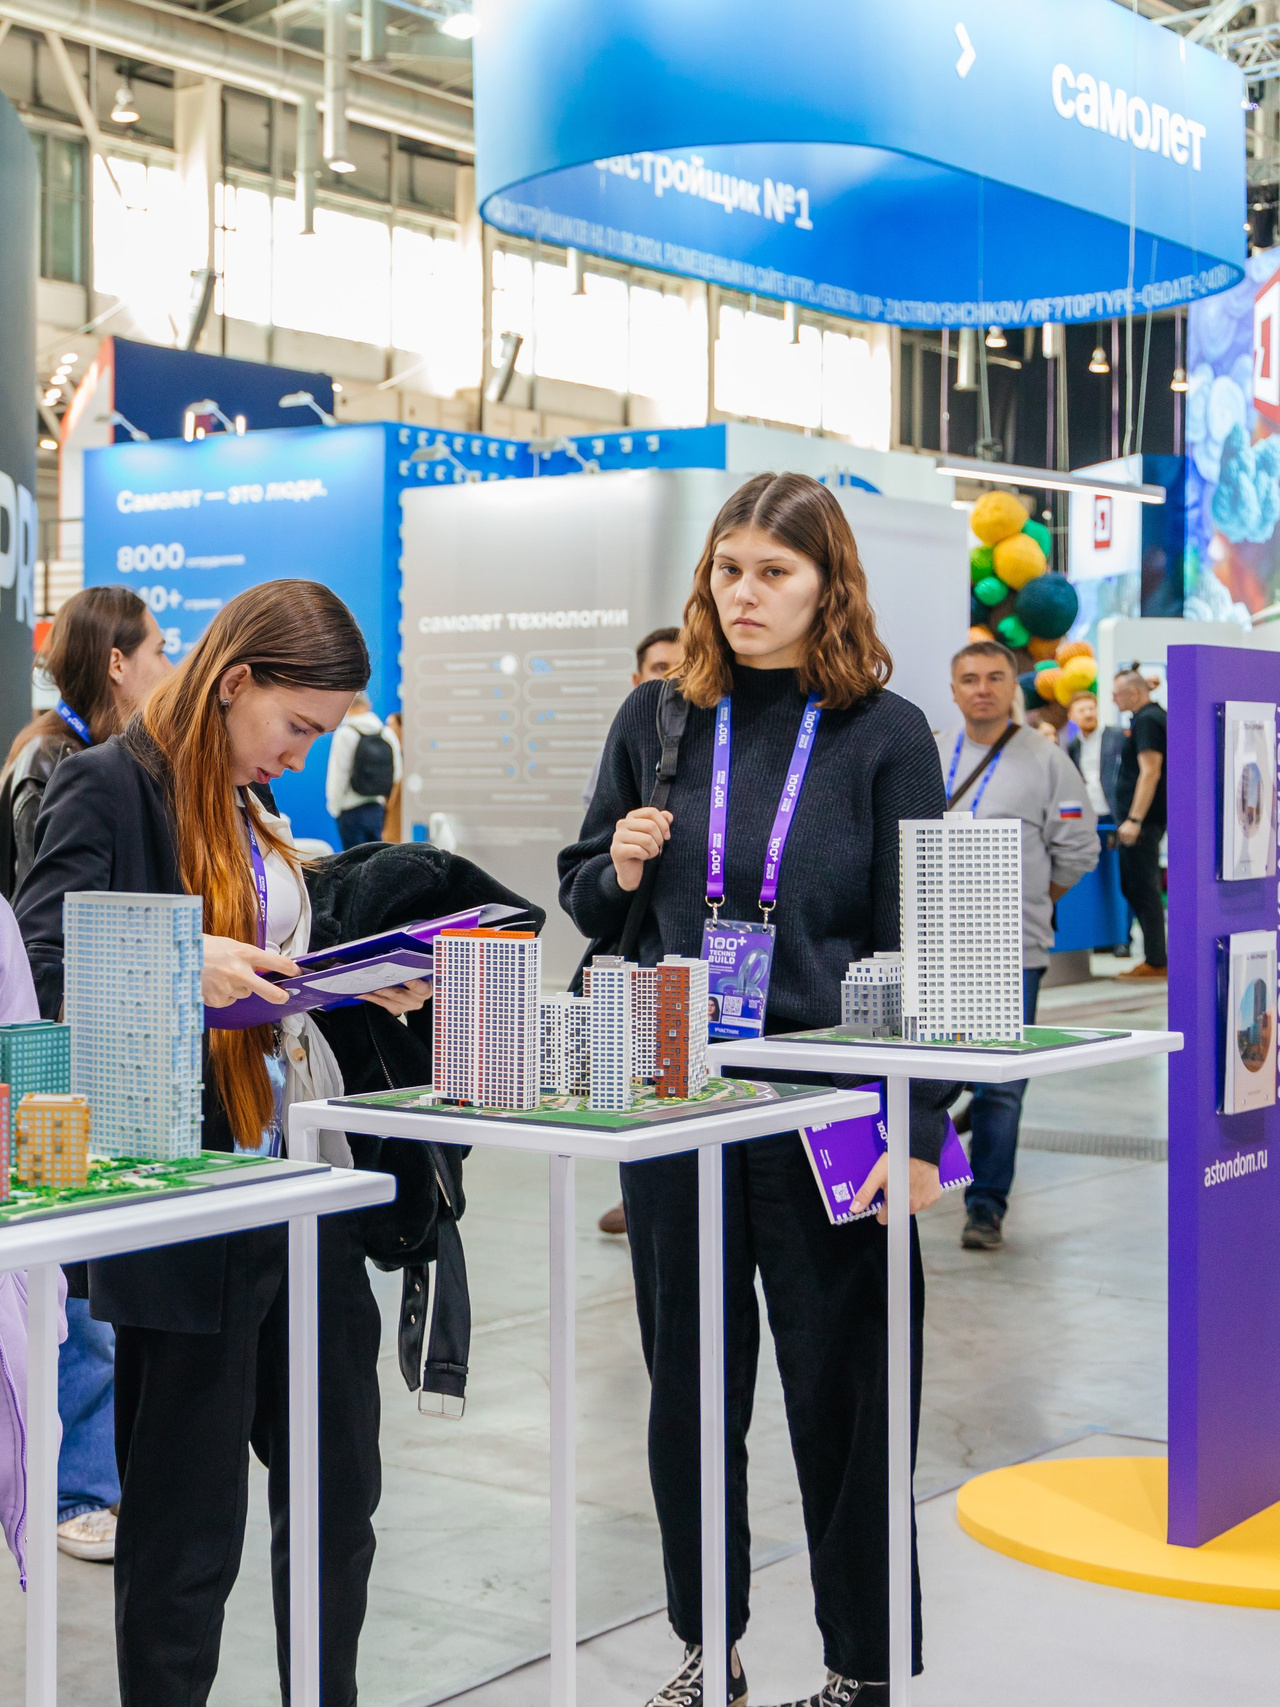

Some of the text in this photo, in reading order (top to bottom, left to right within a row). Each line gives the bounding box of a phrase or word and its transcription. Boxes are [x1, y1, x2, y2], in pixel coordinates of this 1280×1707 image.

[1052, 62, 1207, 173] самолет
[763, 177, 815, 231] №1
[116, 489, 203, 514] Самолет
[228, 484, 264, 505] это
[117, 542, 185, 573] 8000
[418, 609, 629, 634] самолет технологии
[717, 722, 728, 746] 100+
[804, 710, 817, 734] 100+
[714, 785, 724, 809] 100+
[787, 773, 799, 798] 100+
[769, 836, 781, 862] 100+
[710, 849, 721, 876] 100+
[708, 936, 748, 951] 100+
[709, 949, 737, 957] TECHNO
[708, 955, 736, 965] BUILD
[1204, 1149, 1268, 1188] astondom.ru
